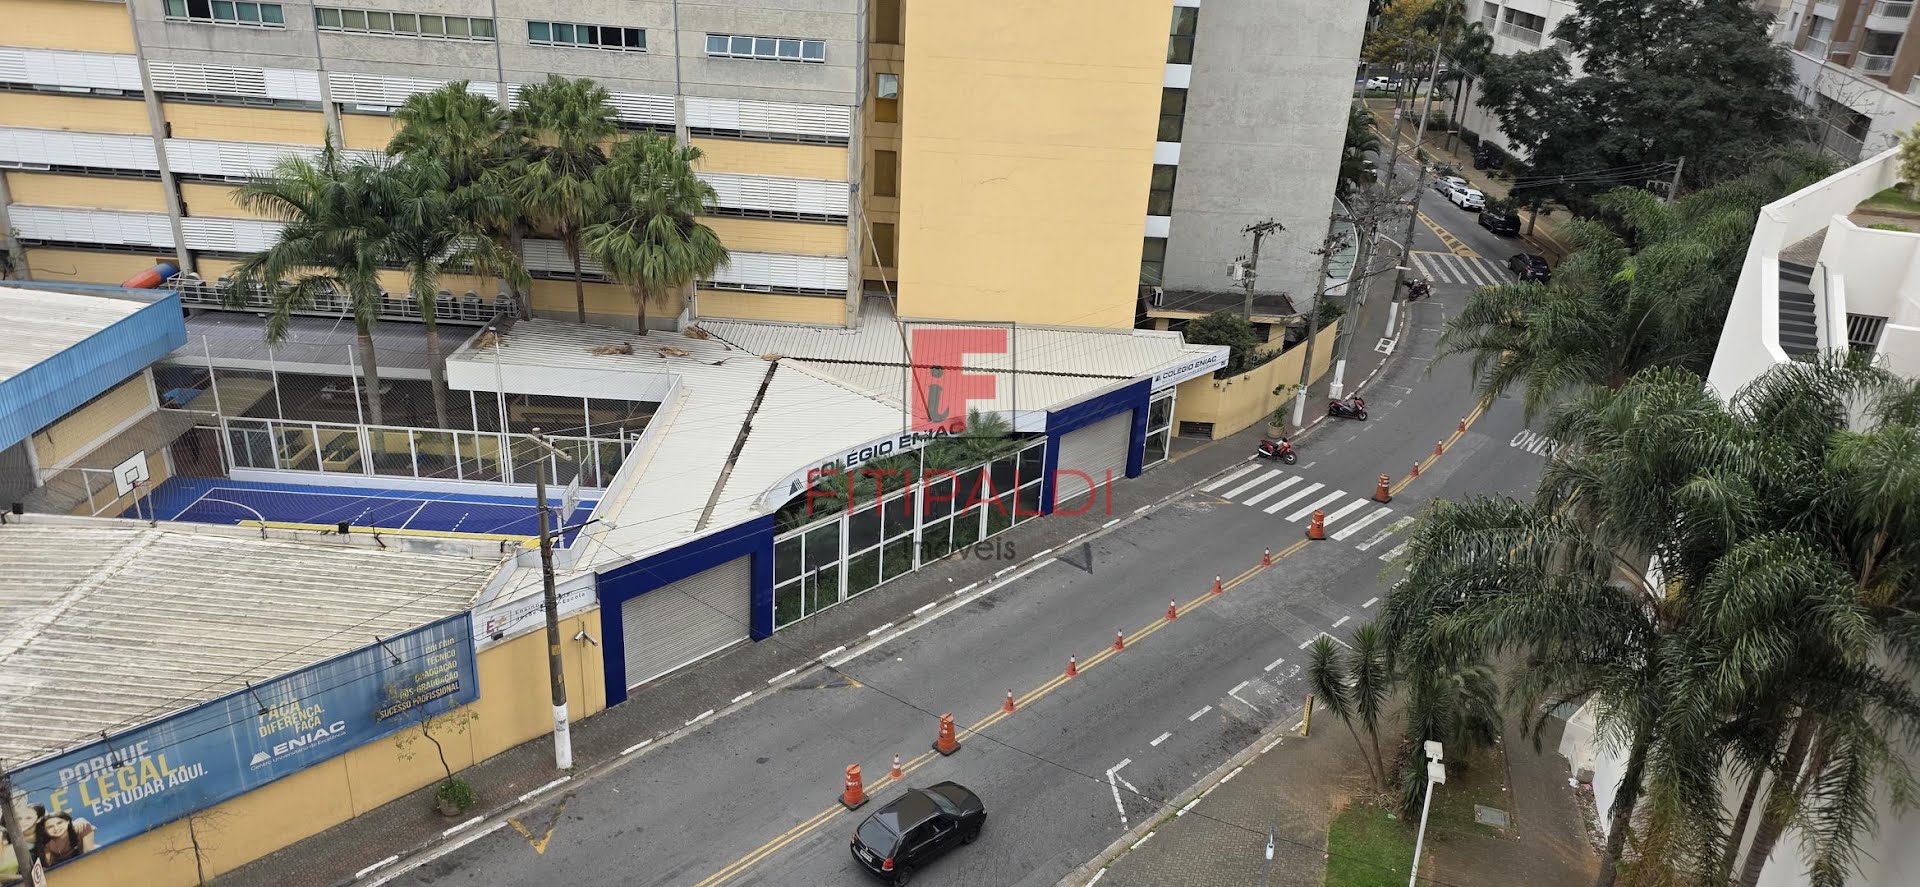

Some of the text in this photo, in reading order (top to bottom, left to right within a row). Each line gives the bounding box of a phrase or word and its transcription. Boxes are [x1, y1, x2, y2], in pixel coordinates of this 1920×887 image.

[1195, 356, 1217, 368] ENIAC
[807, 440, 893, 484] COLÉGIO
[380, 682, 459, 719] SUCESSO PROFISSIONAL
[273, 720, 346, 756] ENIAC
[295, 715, 322, 734] FAÇA
[59, 740, 152, 788] PORQUE
[79, 754, 177, 808] LEGAL
[250, 760, 272, 771] Centro
[92, 762, 209, 817] ESTUDAR AQUI.
